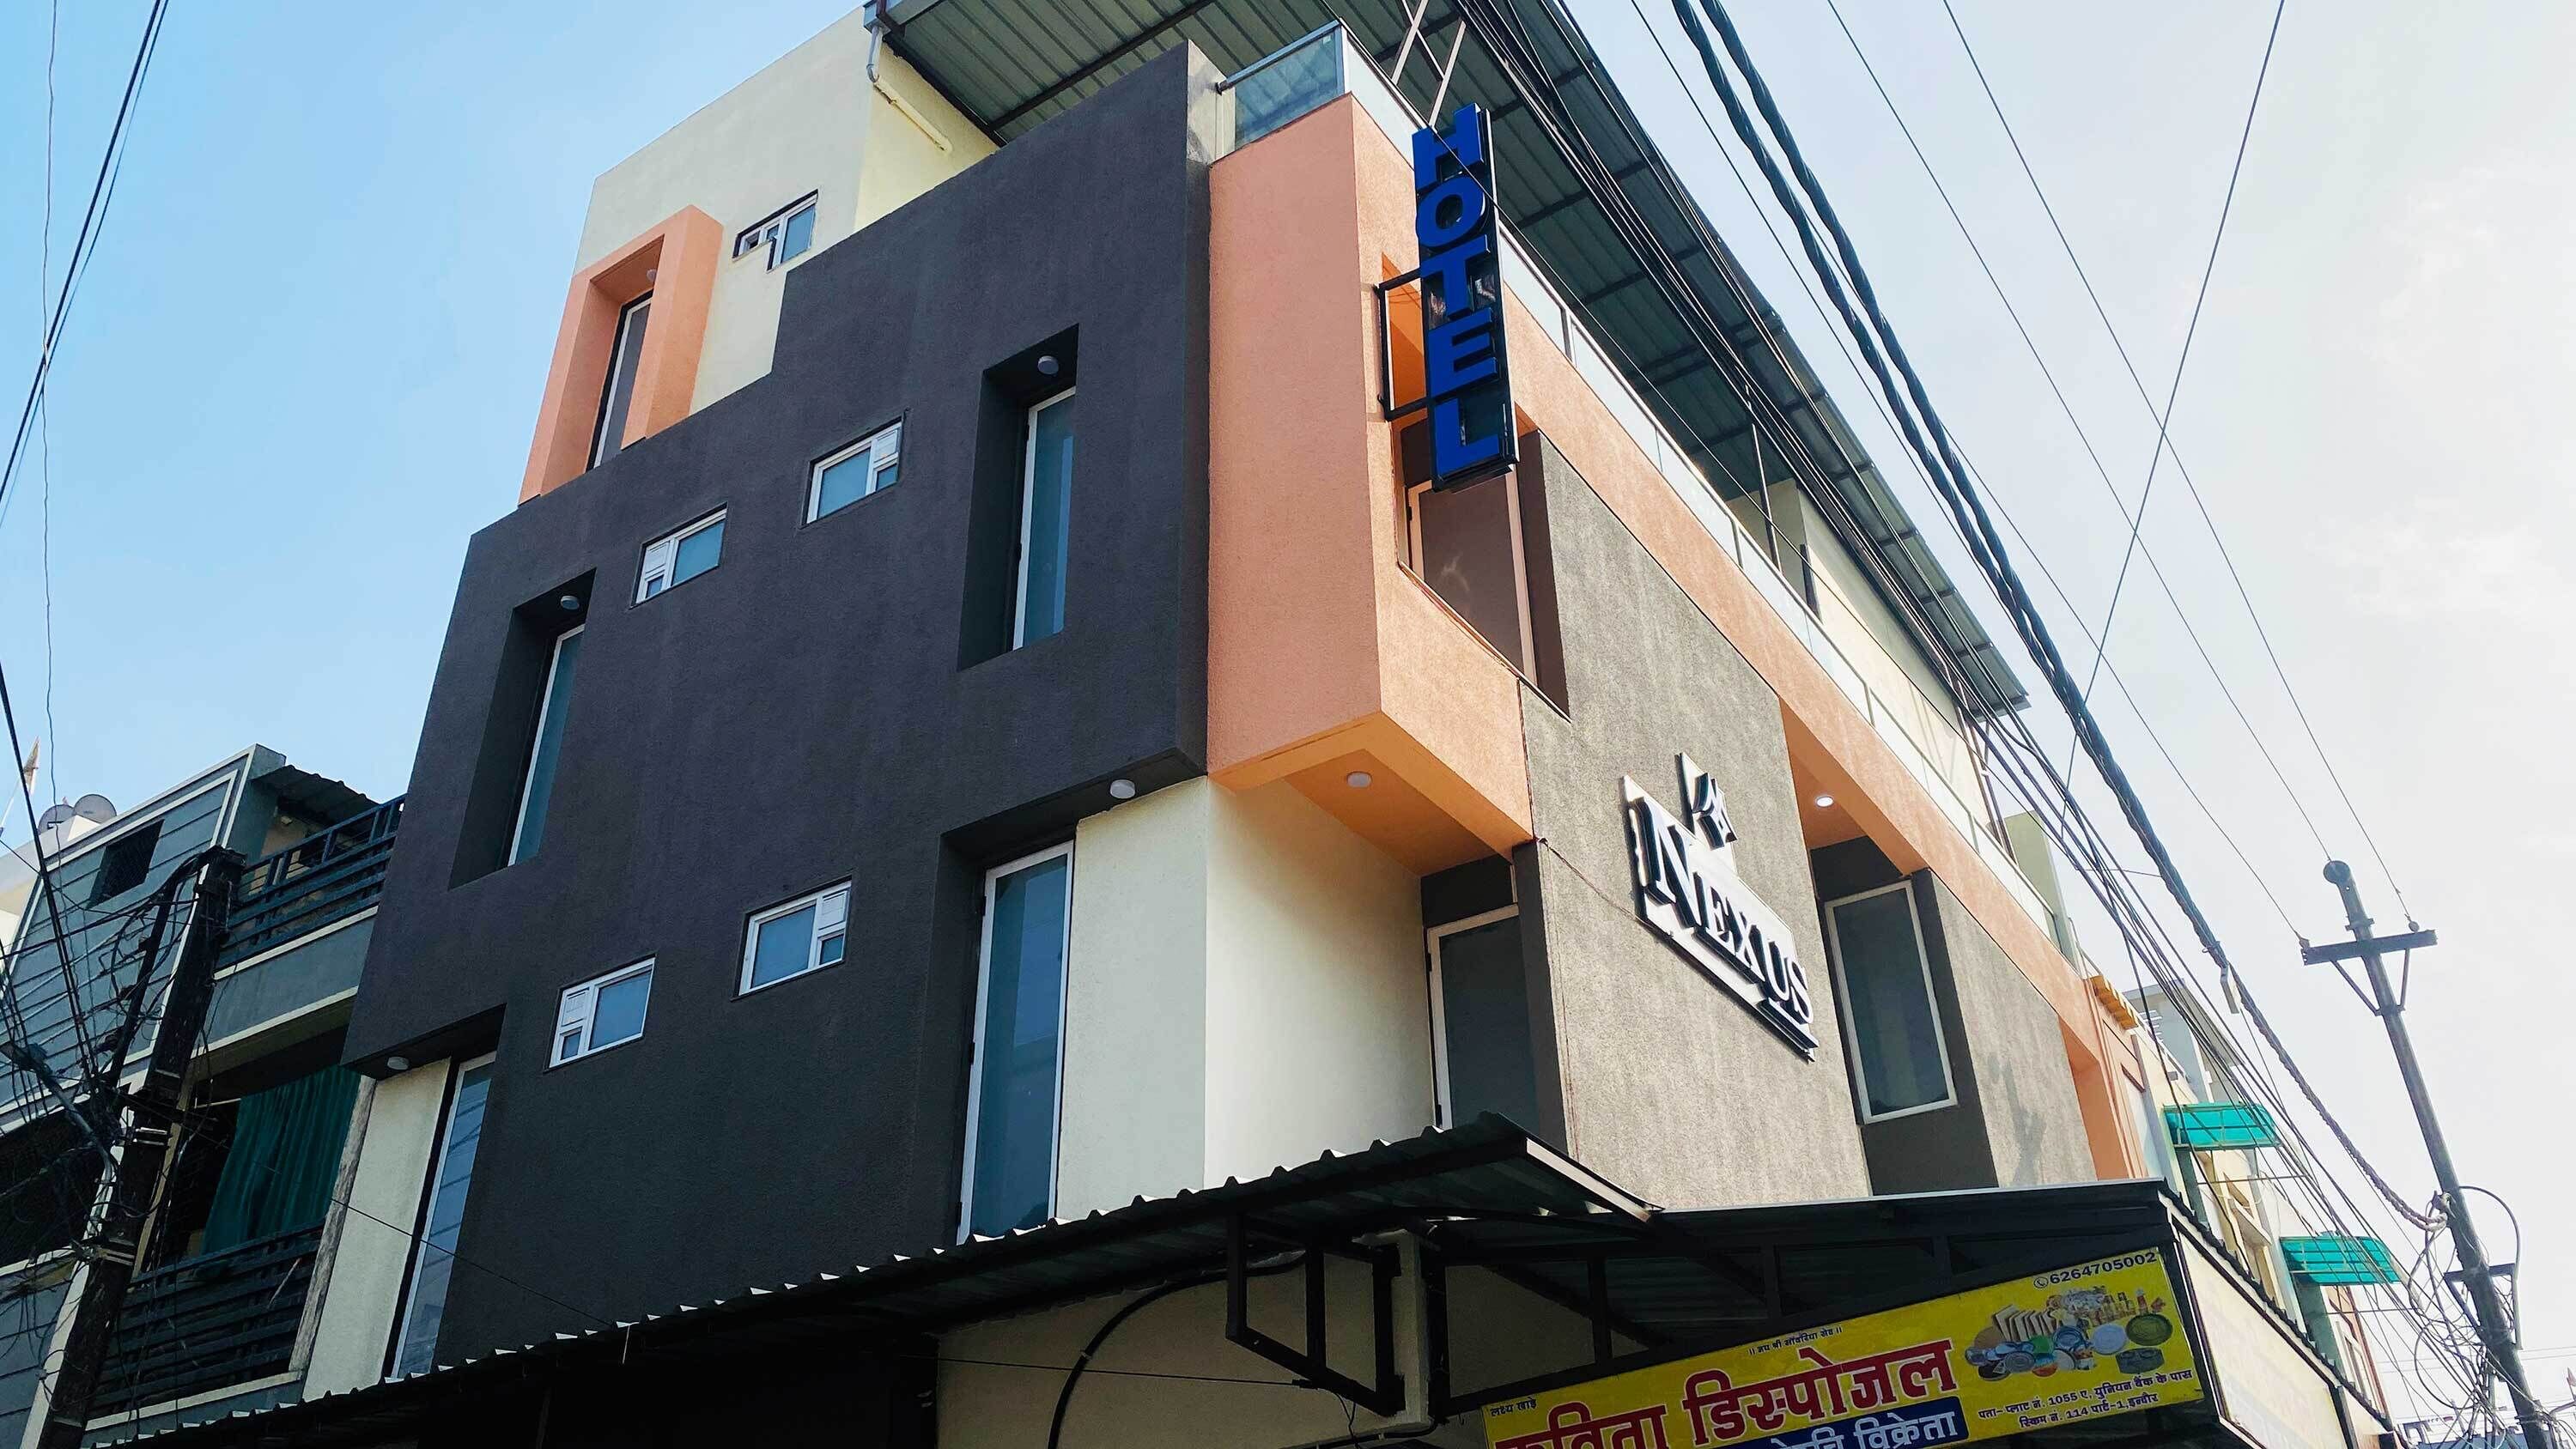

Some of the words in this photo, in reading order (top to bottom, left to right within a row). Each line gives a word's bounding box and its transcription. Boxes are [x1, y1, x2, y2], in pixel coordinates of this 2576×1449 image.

[1411, 102, 1500, 482] HOTEL
[1630, 795, 1814, 1025] NEXUS
[2050, 1252, 2158, 1285] 6264705002
[1772, 1339, 1782, 1349] श्री
[1495, 1401, 1671, 1449] विता
[1681, 1339, 1958, 1446] डिस्पोजल
[2049, 1392, 2078, 1405] 1055
[2156, 1372, 2166, 1383] के
[2170, 1369, 2193, 1380] पास
[2066, 1407, 2088, 1419] 114
